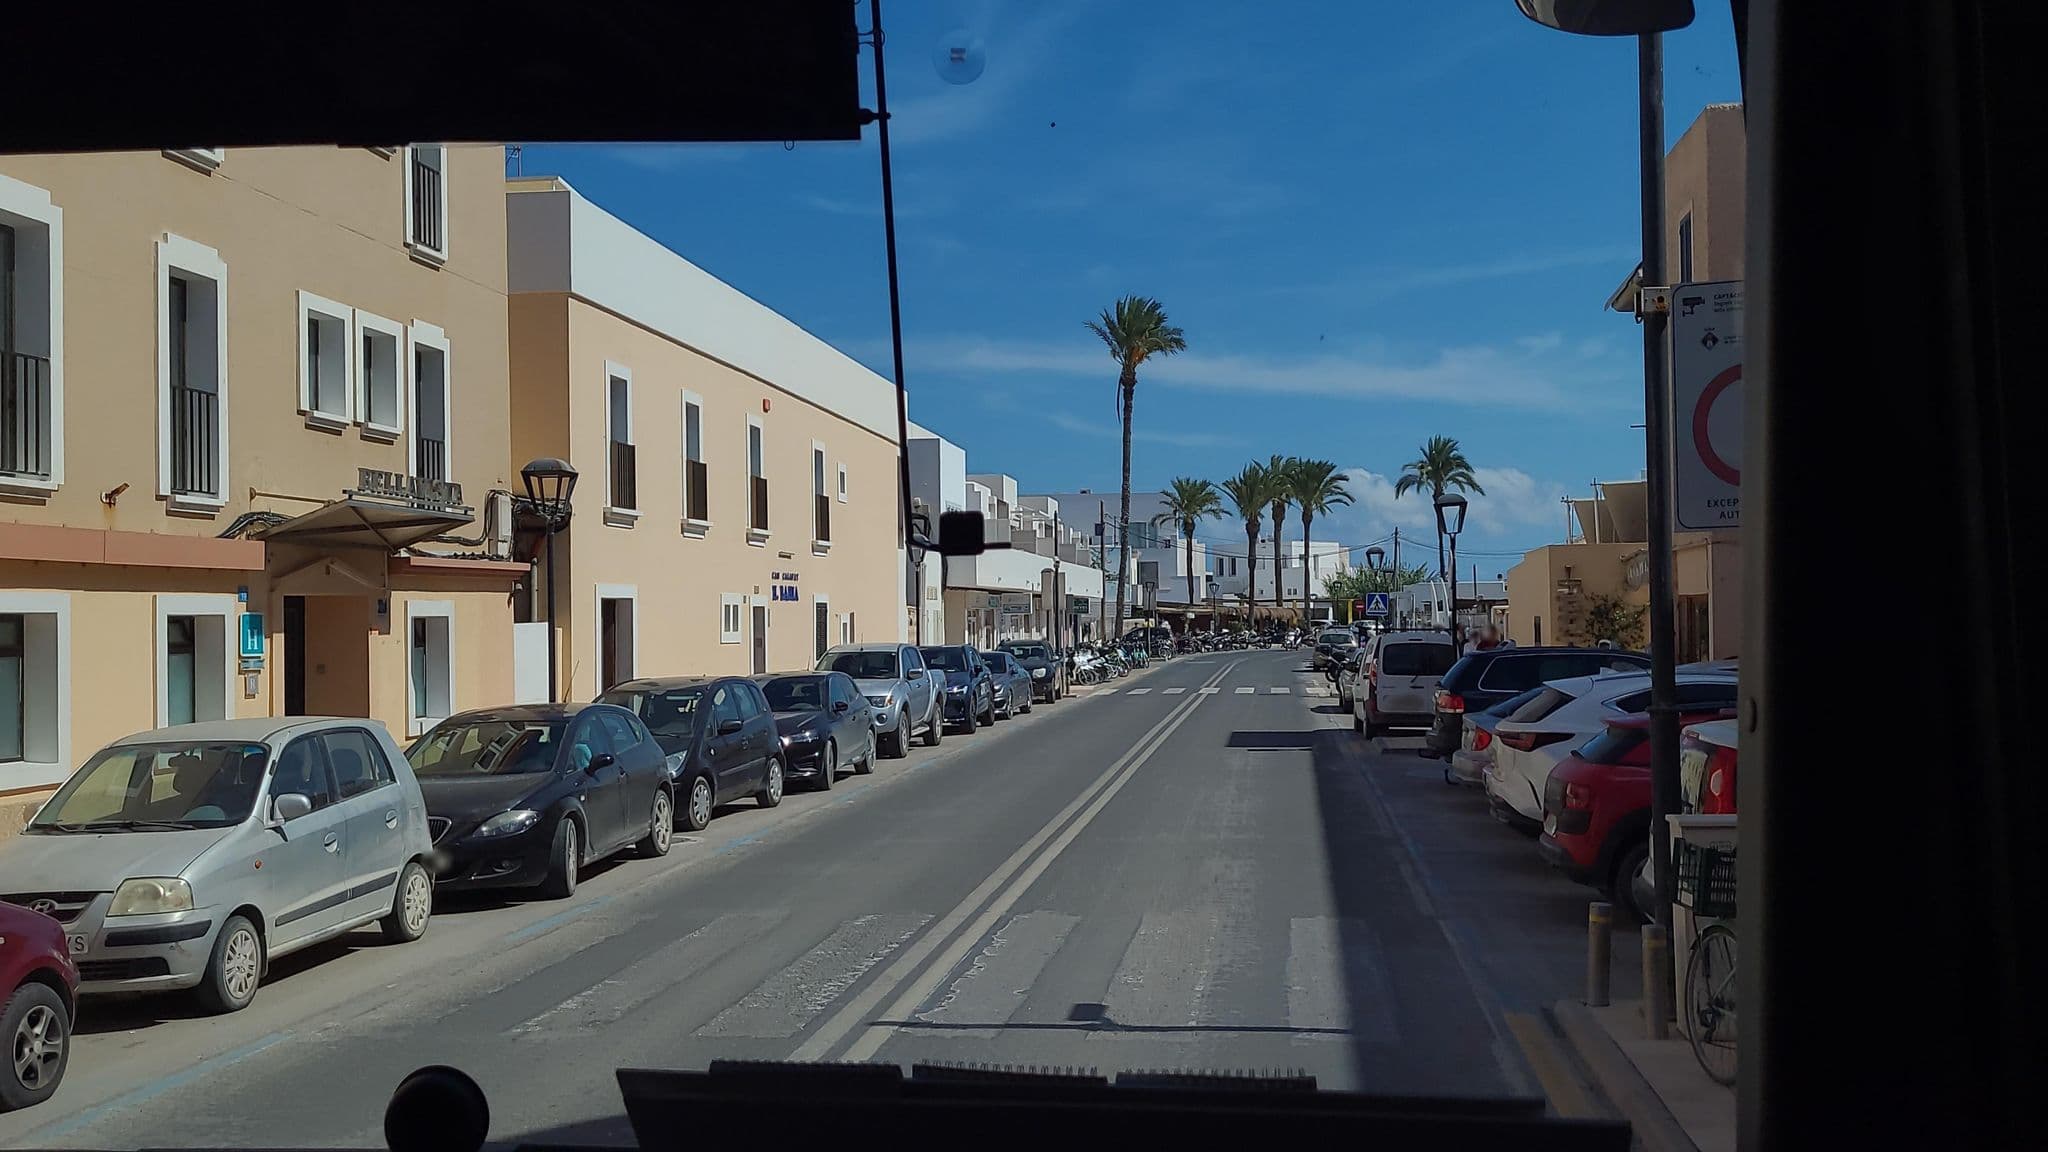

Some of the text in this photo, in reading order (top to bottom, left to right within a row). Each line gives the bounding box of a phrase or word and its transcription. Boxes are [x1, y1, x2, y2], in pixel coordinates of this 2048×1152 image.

[1707, 497, 1739, 508] EXCEP
[1720, 510, 1740, 520] AUT
[247, 628, 259, 650] H
